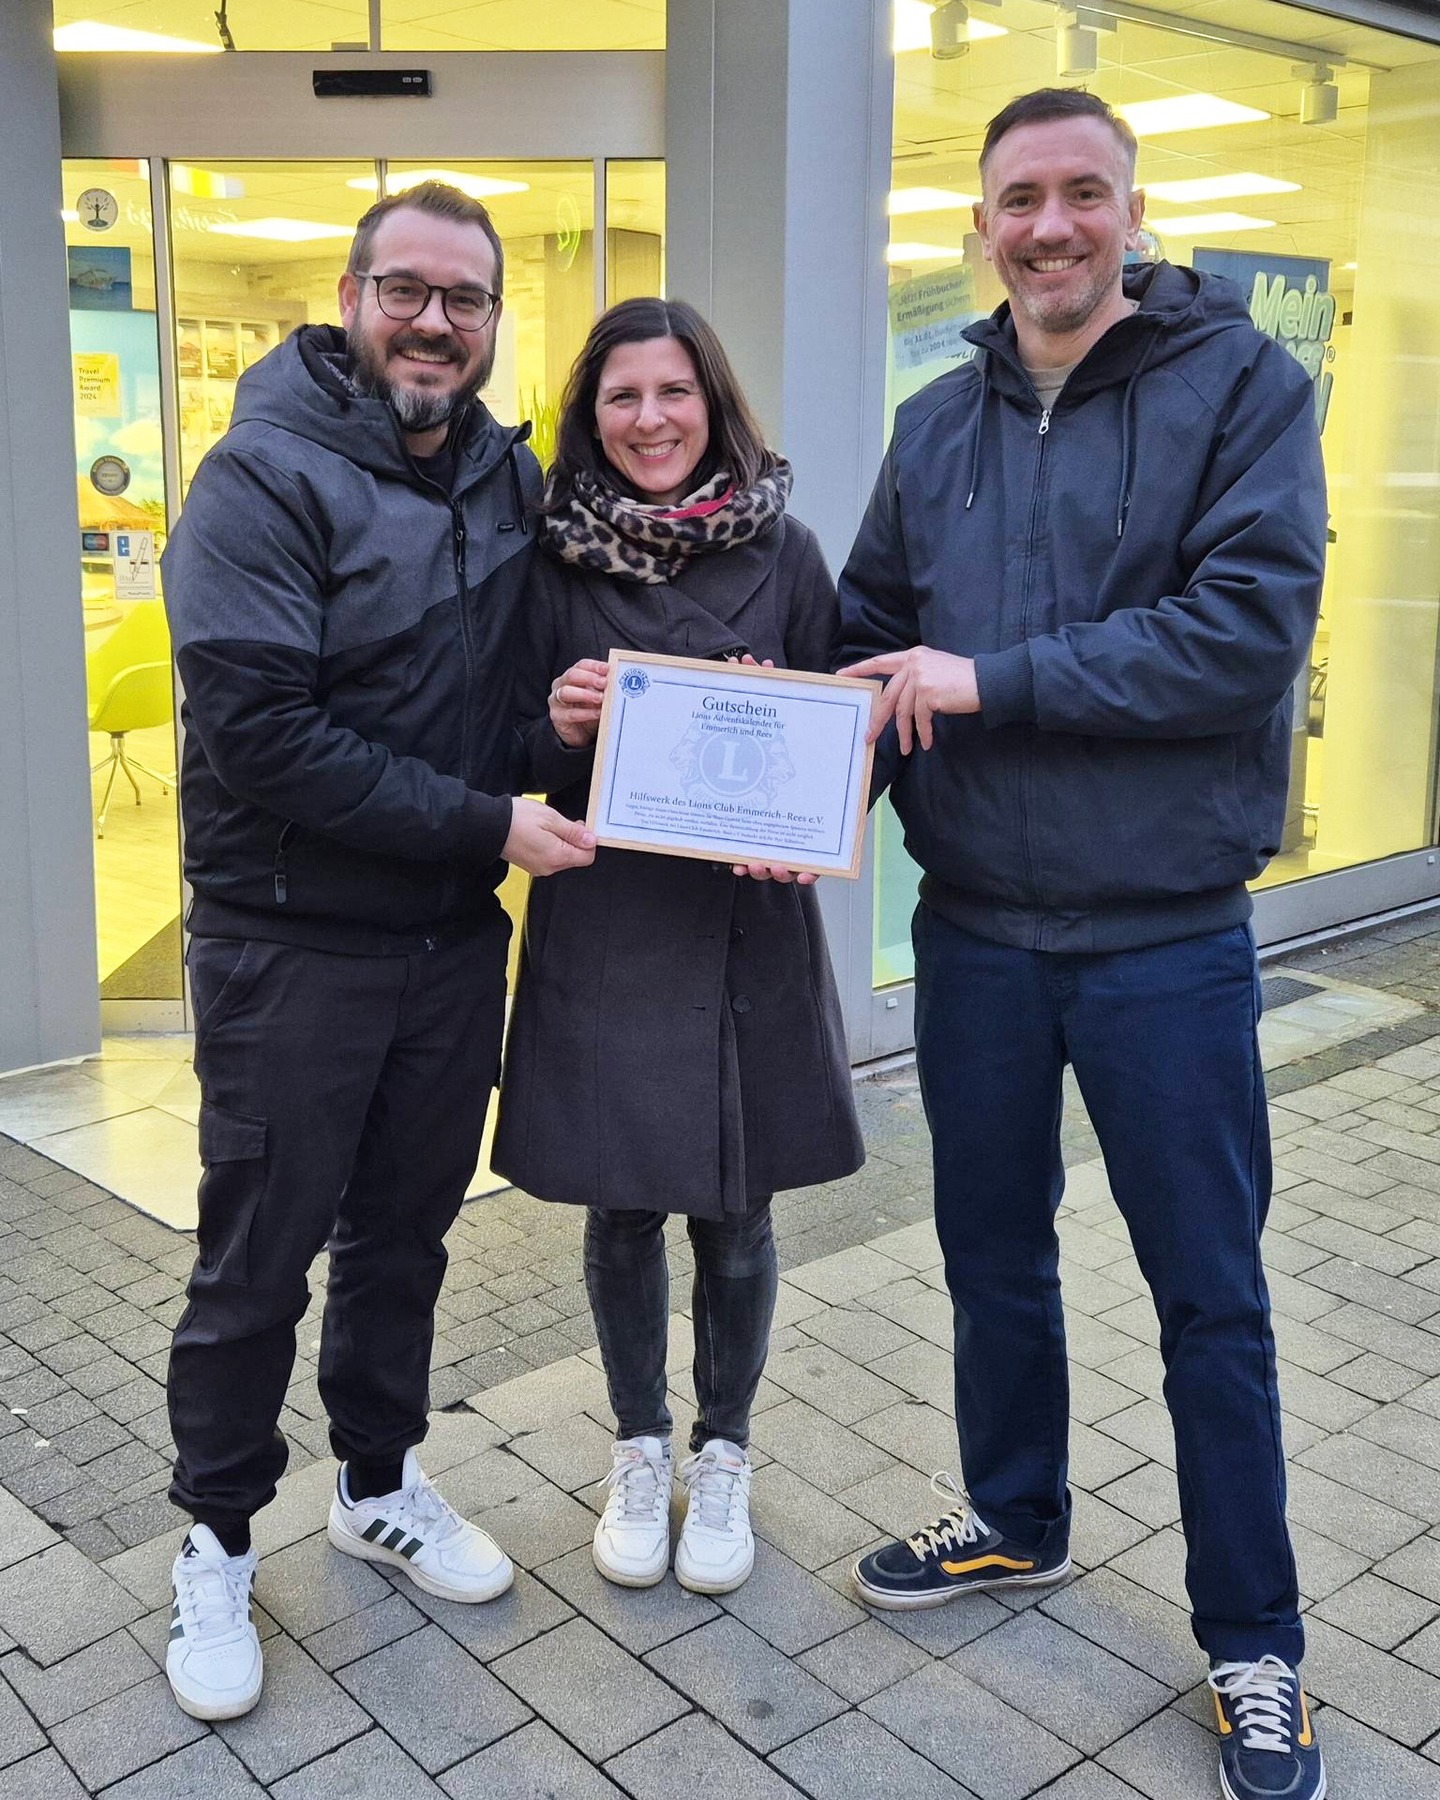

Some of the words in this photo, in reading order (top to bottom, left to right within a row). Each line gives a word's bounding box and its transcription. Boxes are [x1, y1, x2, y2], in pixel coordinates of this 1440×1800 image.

[897, 301, 945, 322] Ermäßigung
[1250, 271, 1335, 342] Mein
[702, 696, 778, 718] Gutschein
[691, 711, 711, 720] Lions
[714, 714, 772, 728] Adventskalender
[774, 721, 786, 730] für
[701, 723, 738, 735] Emmerich
[740, 727, 754, 736] und
[756, 729, 772, 738] Rees
[717, 740, 748, 782] L
[630, 791, 670, 804] Hilfswerk
[672, 797, 686, 806] des
[689, 799, 712, 810] Lions
[714, 802, 735, 812] Club
[737, 805, 806, 822] Emmerich-Rees
